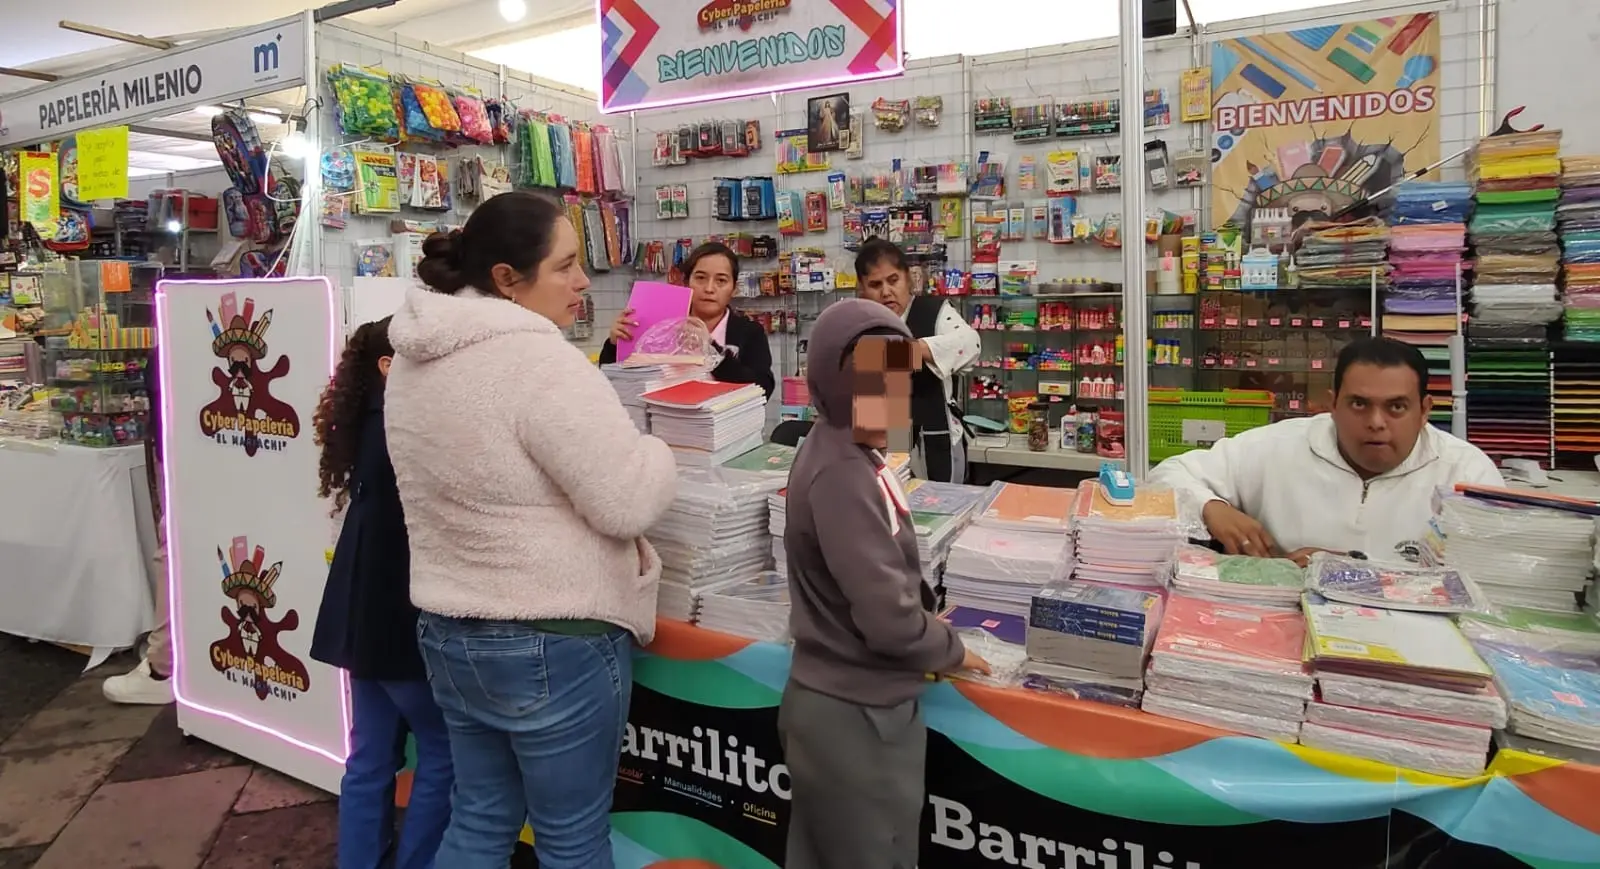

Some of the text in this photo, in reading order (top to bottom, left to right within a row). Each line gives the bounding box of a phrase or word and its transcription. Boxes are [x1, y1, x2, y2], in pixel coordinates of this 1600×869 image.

[701, 8, 731, 21] Cyber
[39, 64, 202, 130] PAPELERÍA MILENIO
[1217, 86, 1437, 131] BIENVENIDOS
[203, 410, 295, 436] Cyber Papelería
[213, 646, 305, 691] Cyber Papelería
[620, 721, 792, 800] arrilito
[664, 776, 722, 803] Manualidades
[743, 801, 777, 820] Oficina
